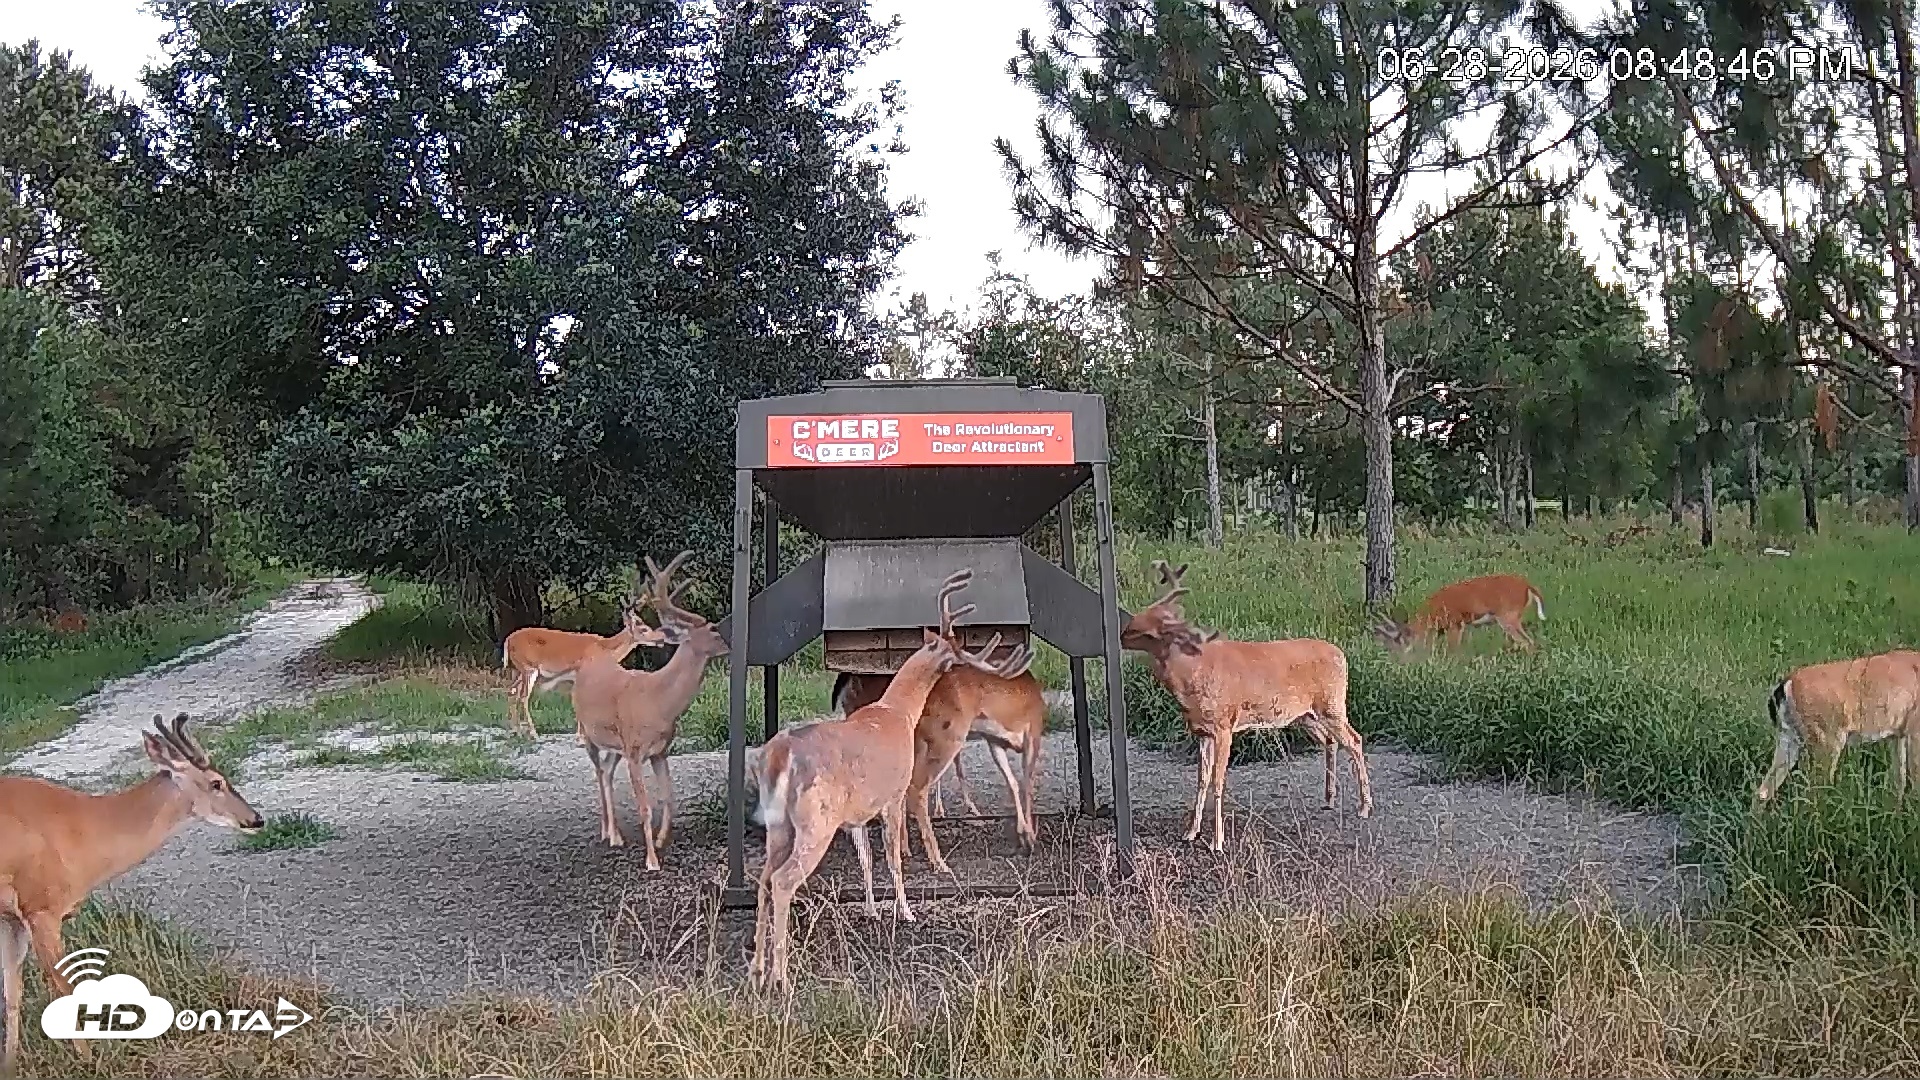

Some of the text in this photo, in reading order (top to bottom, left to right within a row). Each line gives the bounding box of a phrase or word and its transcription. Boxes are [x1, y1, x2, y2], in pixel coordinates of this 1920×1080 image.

[792, 419, 900, 439] C'MERE
[923, 423, 1054, 437] The Revolutionary
[821, 447, 871, 457] DEER
[932, 441, 1045, 453] Deer Attractant
